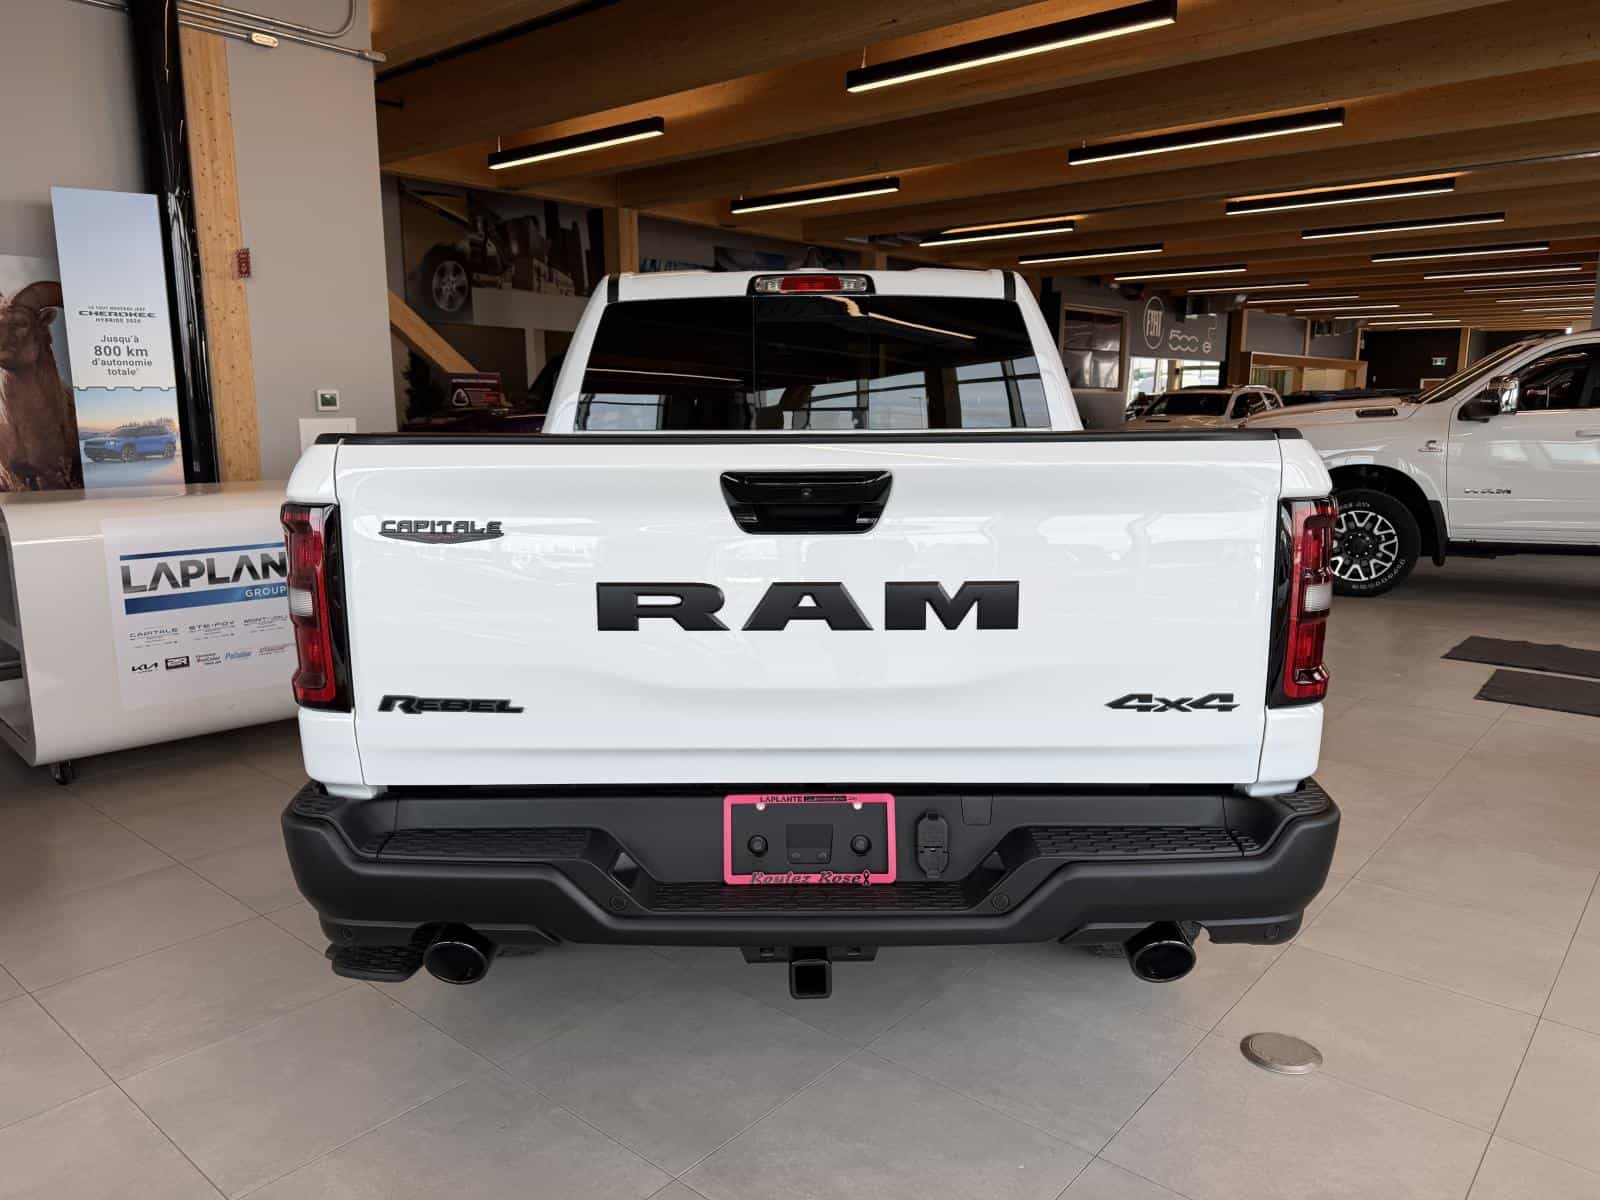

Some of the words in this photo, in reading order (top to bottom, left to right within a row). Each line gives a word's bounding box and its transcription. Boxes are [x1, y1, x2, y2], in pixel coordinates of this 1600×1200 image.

[79, 310, 158, 318] CHEROKEE
[1146, 310, 1163, 337] FIAT
[101, 335, 139, 344] Jusqu'à
[94, 345, 121, 357] 800
[127, 346, 148, 357] km
[92, 358, 152, 366] d'autonomie
[381, 520, 503, 534] CAPITALE
[597, 581, 1019, 631] RAM
[131, 662, 158, 672] KIA
[378, 695, 524, 713] REBEL
[752, 871, 812, 884] Roulez
[818, 871, 862, 884] Rose
